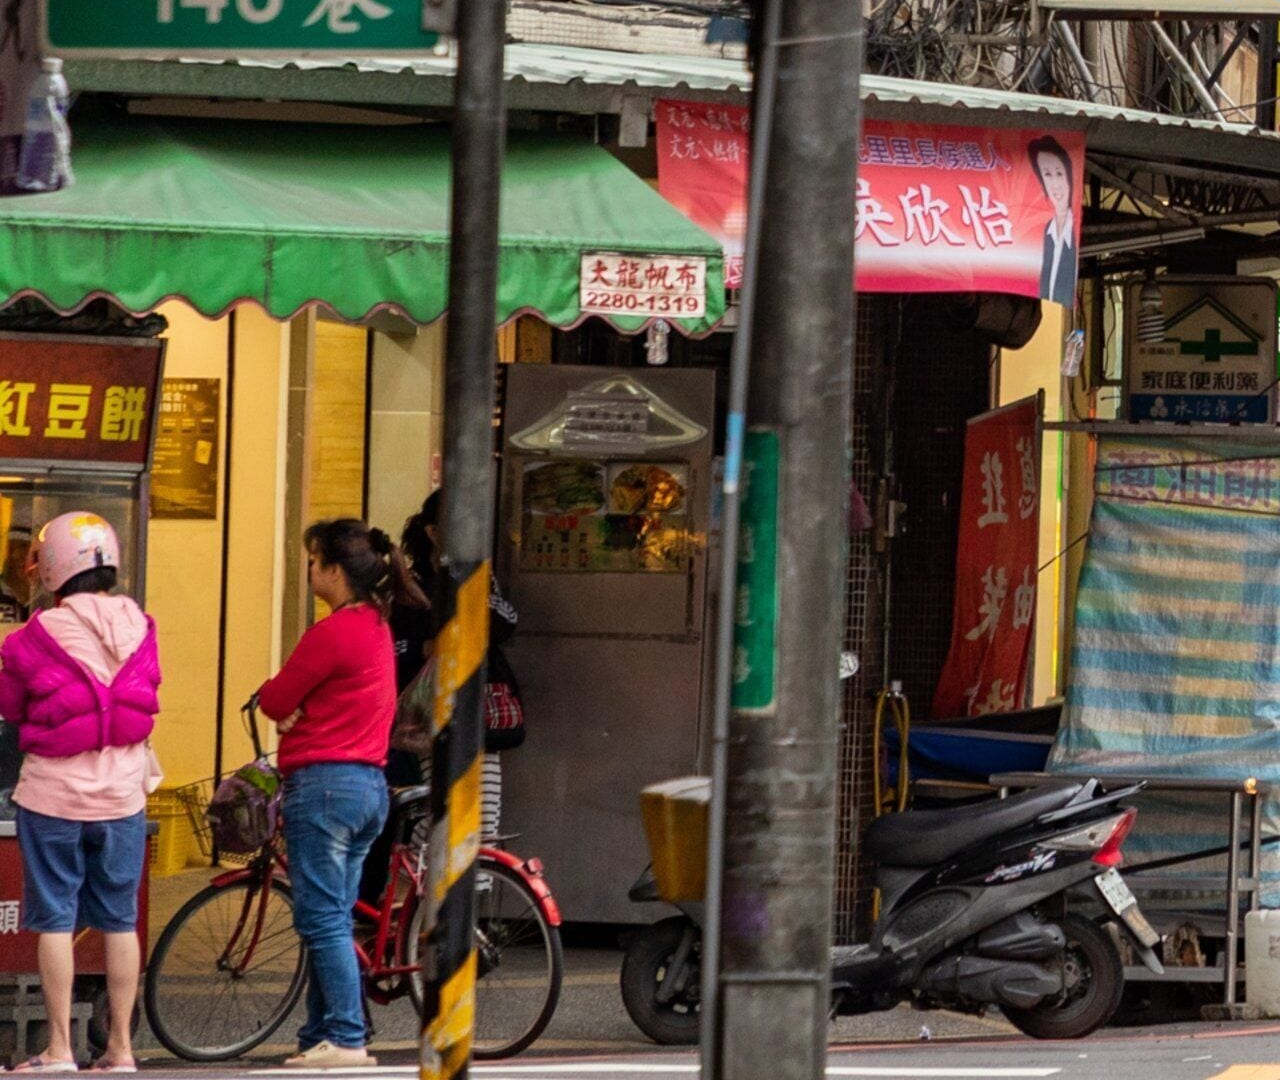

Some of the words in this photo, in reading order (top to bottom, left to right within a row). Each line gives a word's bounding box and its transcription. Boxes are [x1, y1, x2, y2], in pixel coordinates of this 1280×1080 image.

[589, 259, 698, 292] 大龍帆布
[586, 291, 699, 313] 2280-1319
[1140, 370, 1259, 392] 家庭便利藥
[0, 382, 148, 443] 紅豆餅
